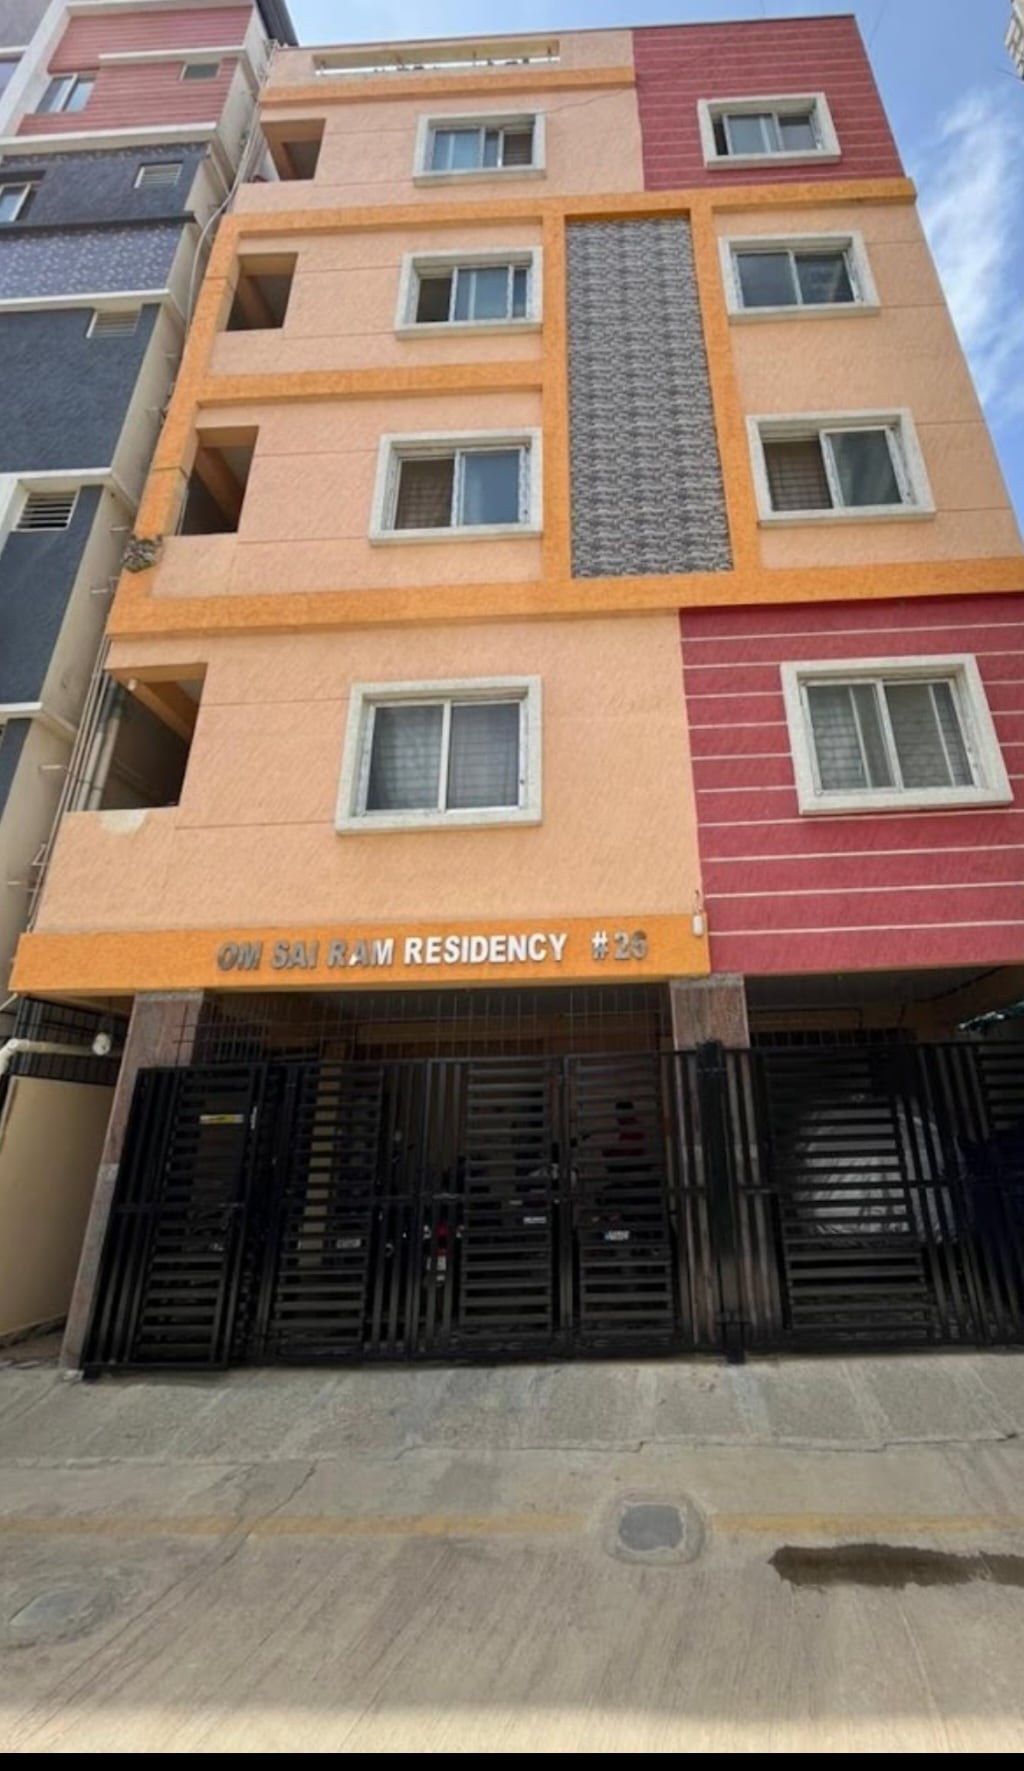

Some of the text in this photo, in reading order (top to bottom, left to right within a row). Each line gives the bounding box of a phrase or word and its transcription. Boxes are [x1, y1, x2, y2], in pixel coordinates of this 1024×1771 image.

[217, 940, 262, 971] OM
[272, 939, 318, 969] SAI
[327, 937, 394, 968] RAM
[403, 933, 568, 964] RESIDENCY
